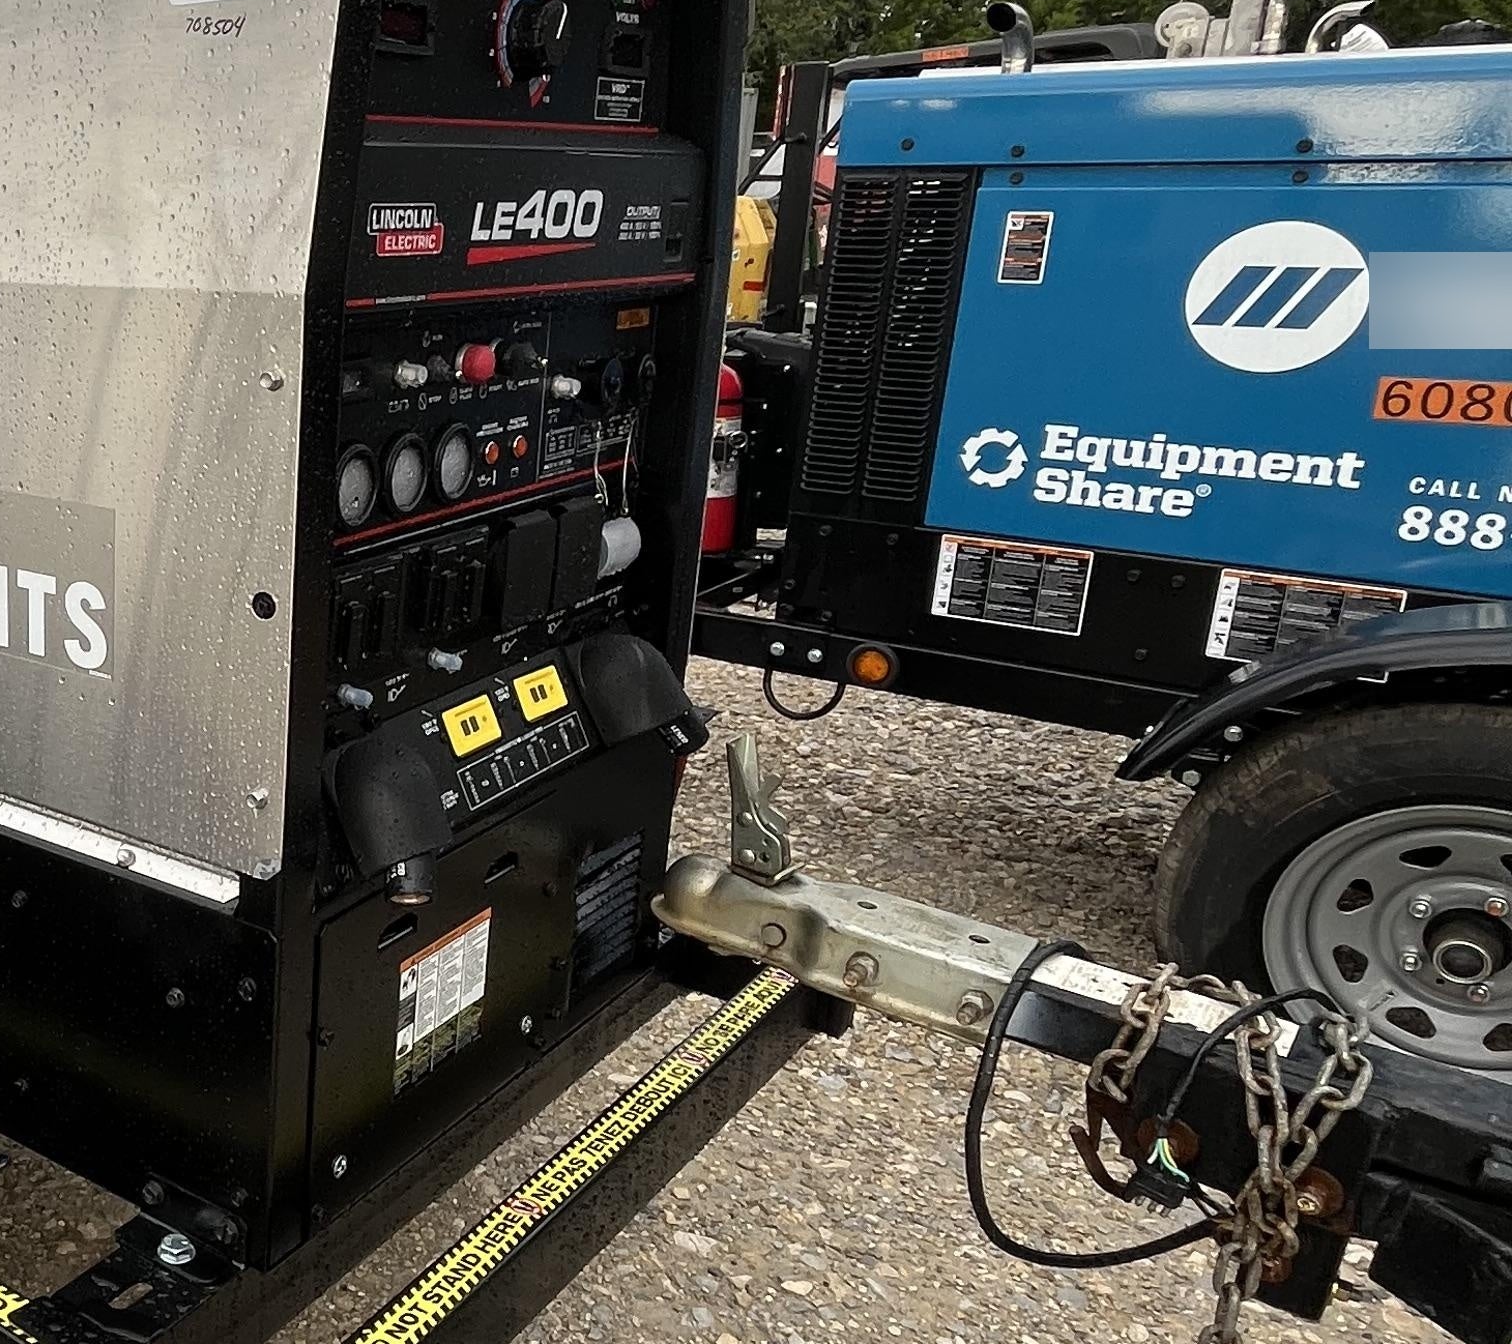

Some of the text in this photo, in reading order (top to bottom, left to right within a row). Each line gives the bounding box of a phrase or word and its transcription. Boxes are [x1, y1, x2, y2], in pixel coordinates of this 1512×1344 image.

[372, 209, 432, 230] LINCOLN
[470, 189, 604, 242] LE400
[384, 235, 437, 251] ELECTRIC
[1382, 380, 1512, 424] 608
[1040, 424, 1365, 490] Equipment
[1409, 476, 1481, 500] CALL
[1398, 506, 1512, 550] 888
[532, 1064, 694, 1203] NE PAS TENEZ DEBOUT ICI
[385, 1302, 429, 1340] NOT
[422, 1253, 482, 1305] STAND
[473, 1211, 524, 1254] HERE
